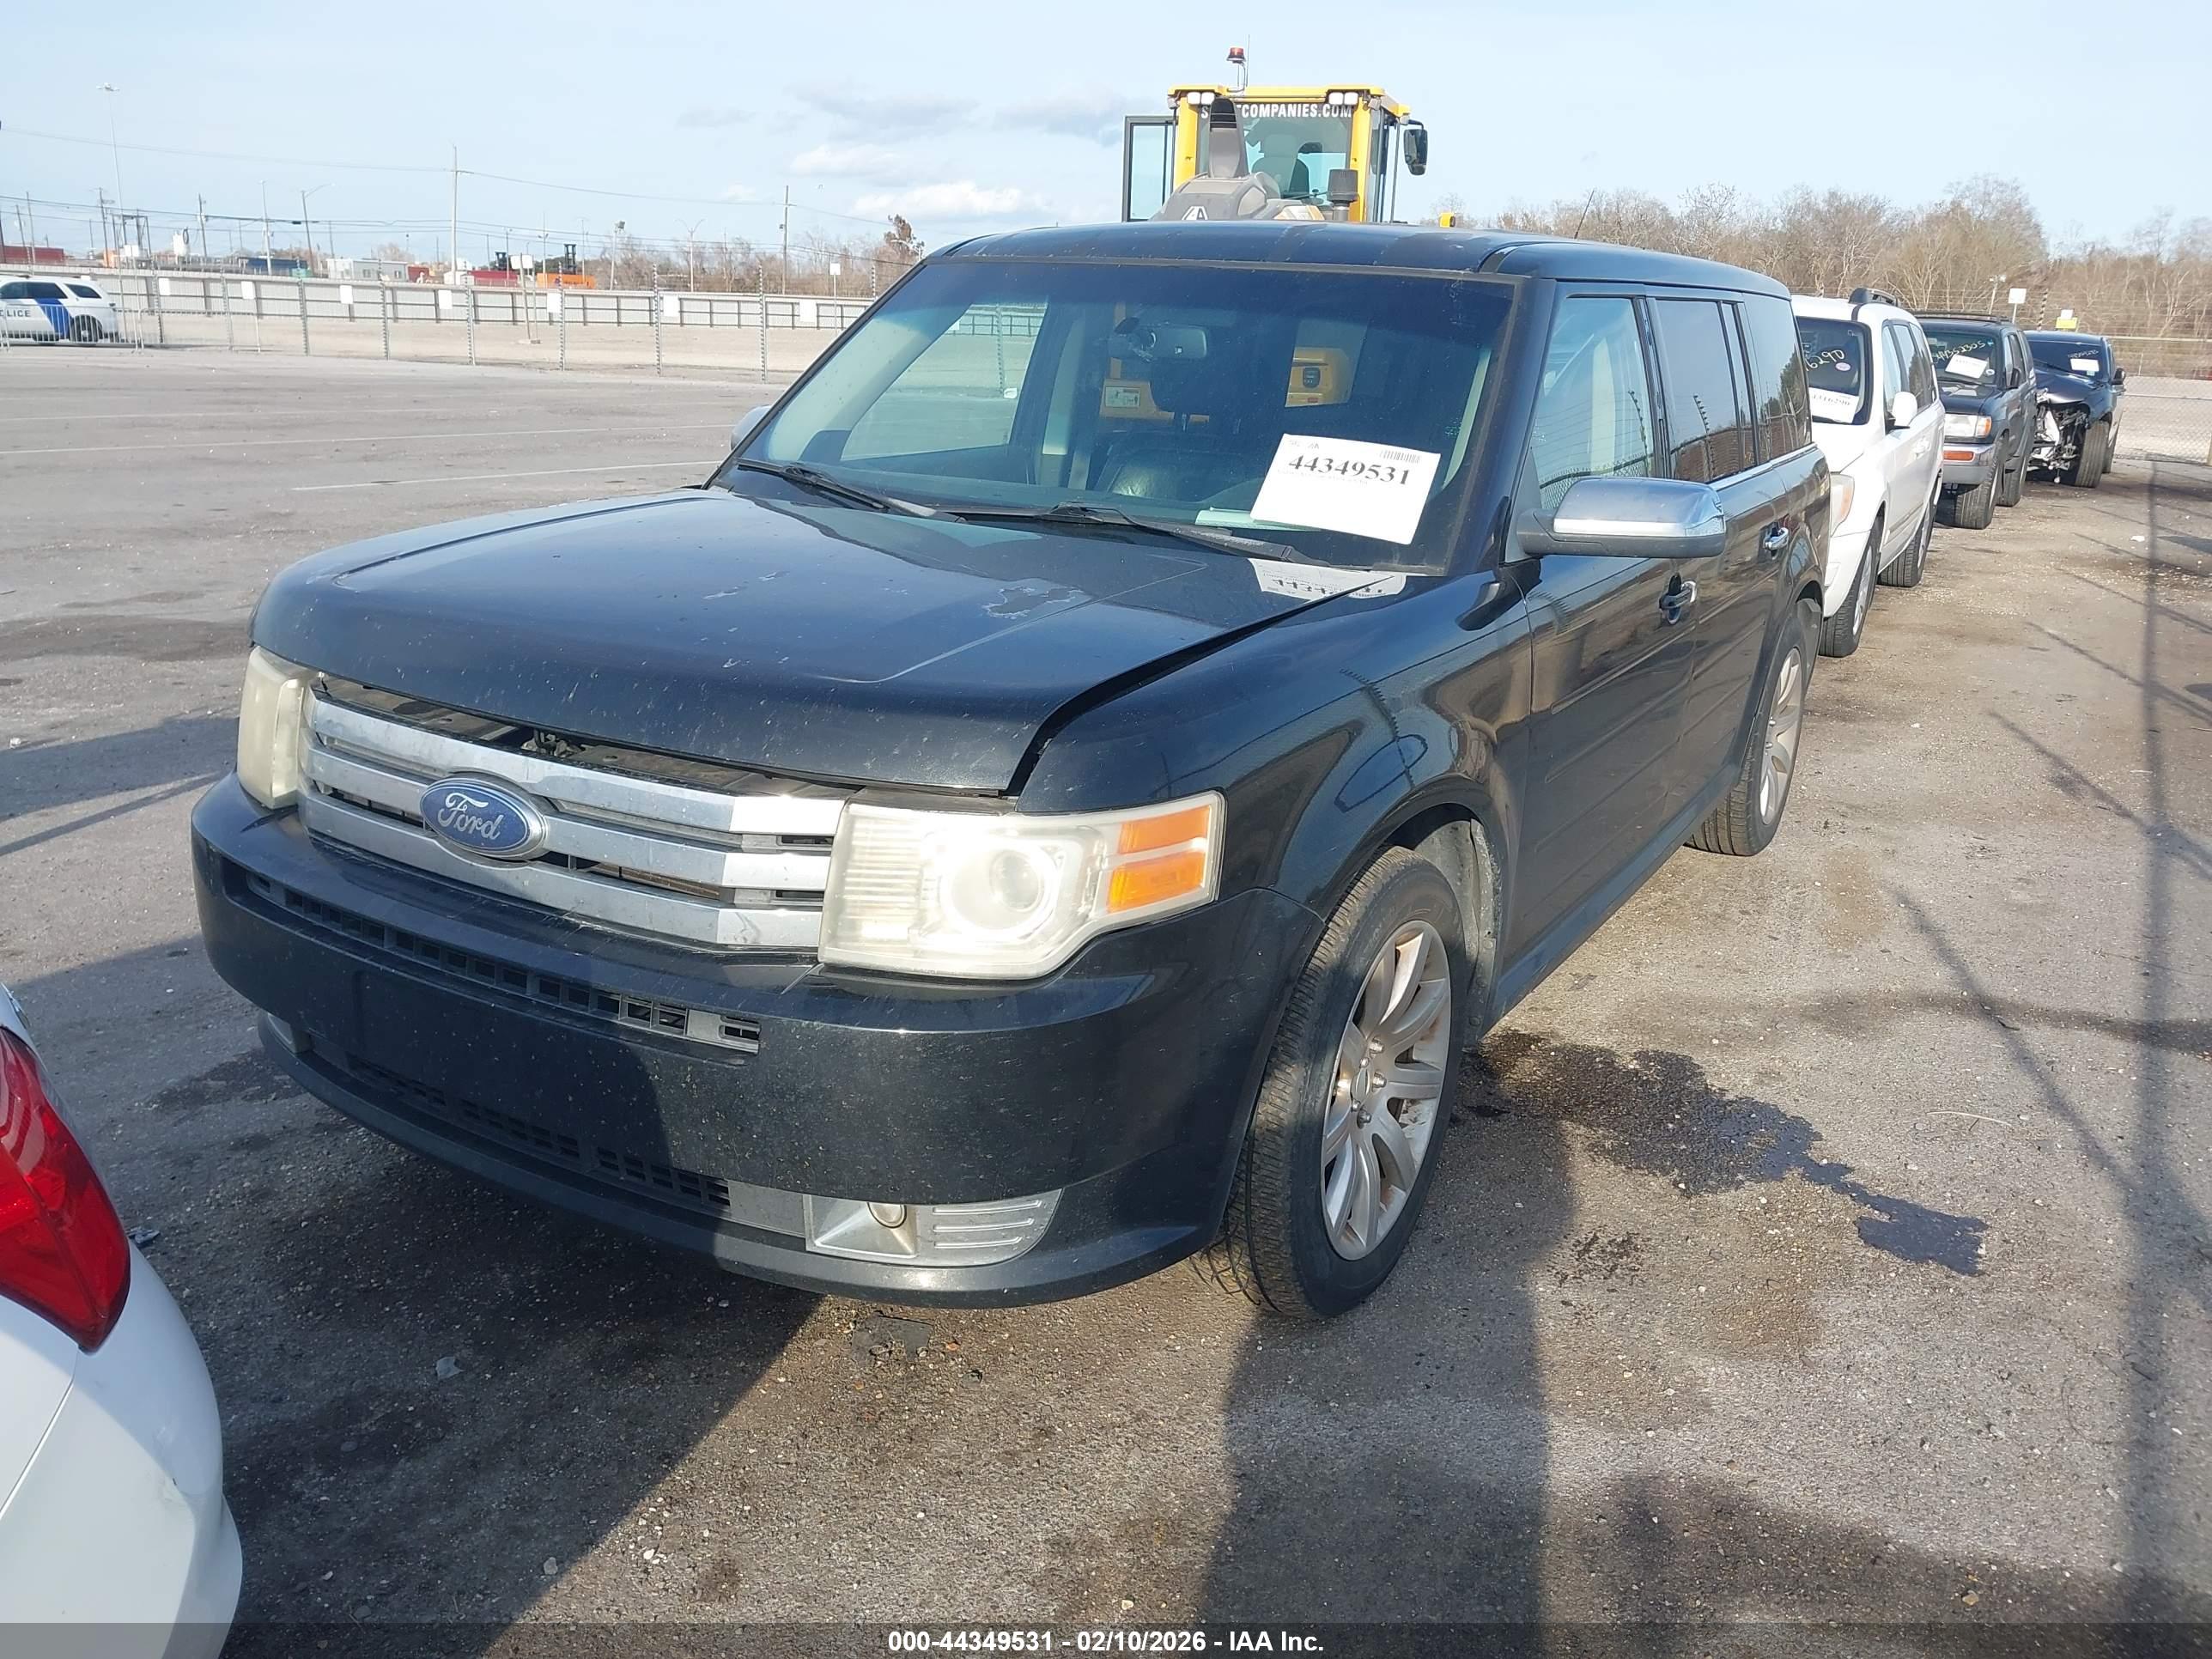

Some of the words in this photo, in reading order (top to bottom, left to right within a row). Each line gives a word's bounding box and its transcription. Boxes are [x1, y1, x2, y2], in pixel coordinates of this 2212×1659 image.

[1200, 103, 1352, 118] SCOMPANIES.COM
[1805, 350, 1844, 371] 6290
[1289, 455, 1410, 485] 44349531
[437, 792, 504, 840] Ford
